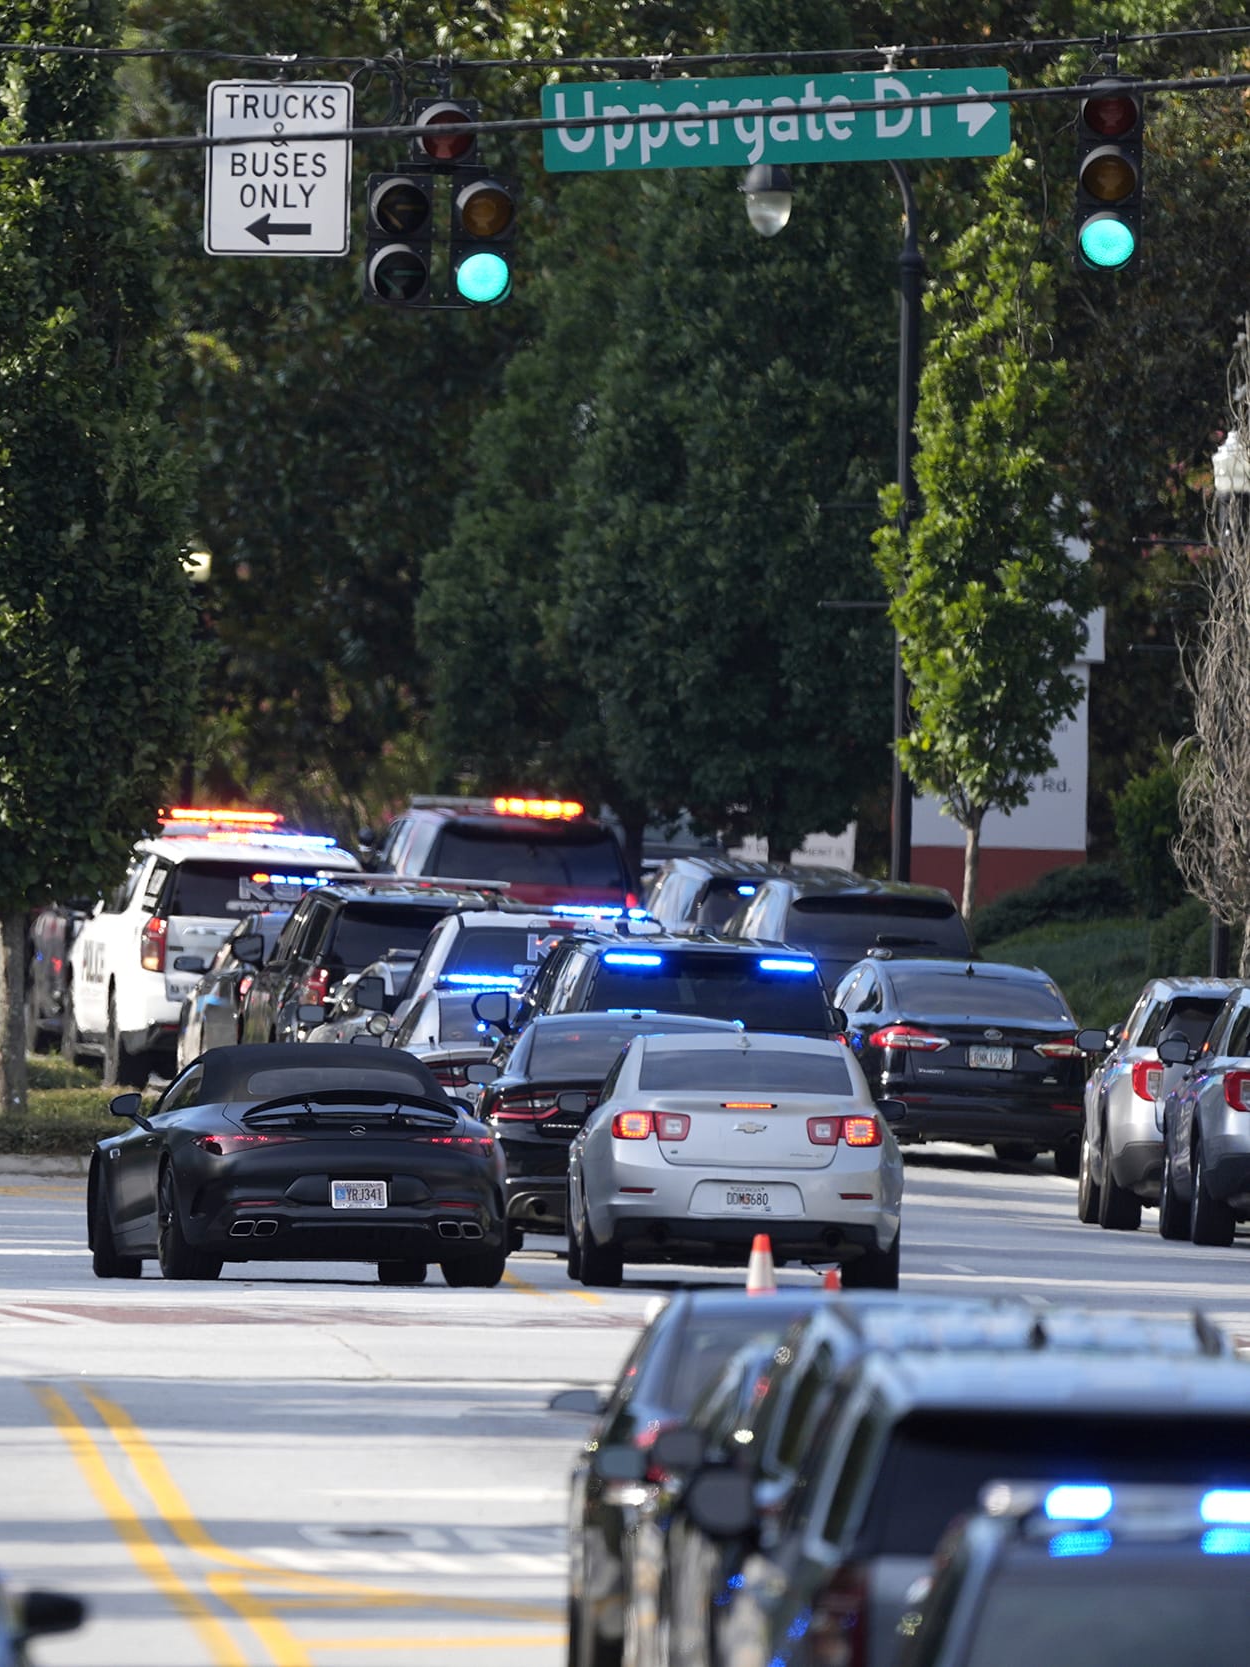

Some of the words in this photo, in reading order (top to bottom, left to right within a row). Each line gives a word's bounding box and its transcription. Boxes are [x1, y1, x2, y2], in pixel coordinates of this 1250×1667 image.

[225, 94, 336, 119] TRUCKS
[554, 80, 855, 167] Uppergate
[874, 78, 944, 139] Dr
[231, 152, 327, 178] BUSES
[240, 183, 316, 208] ONLY
